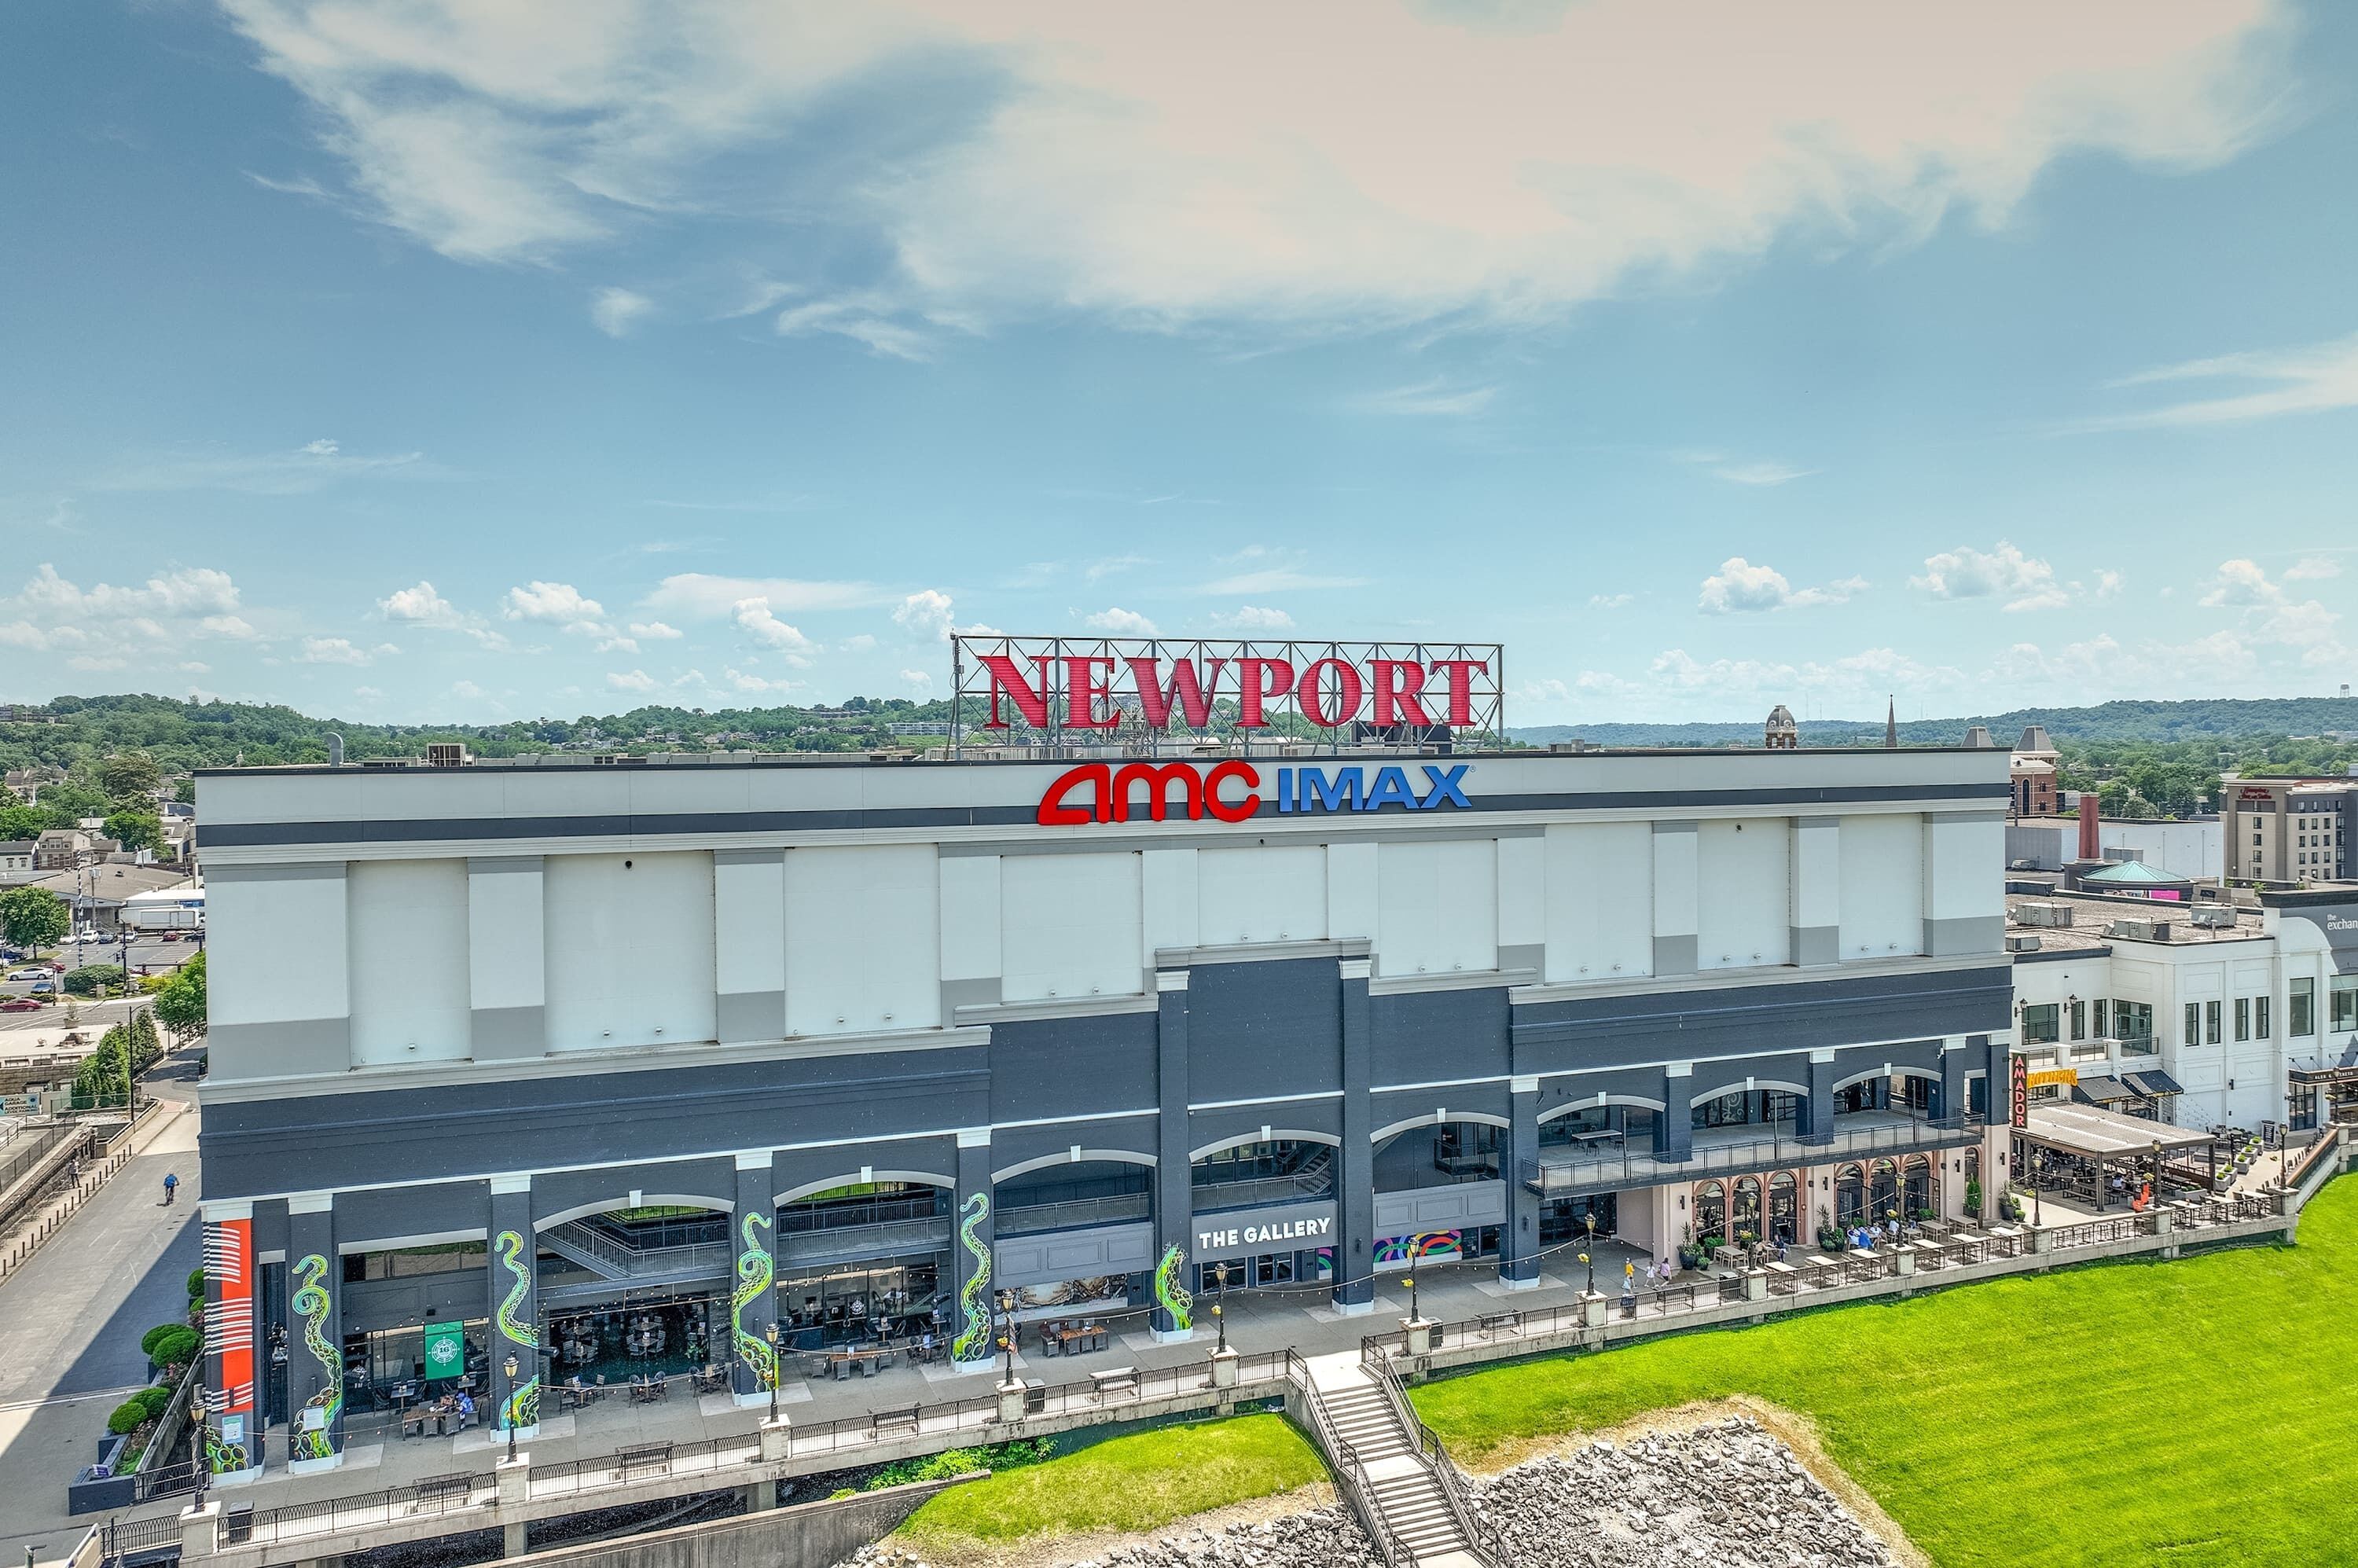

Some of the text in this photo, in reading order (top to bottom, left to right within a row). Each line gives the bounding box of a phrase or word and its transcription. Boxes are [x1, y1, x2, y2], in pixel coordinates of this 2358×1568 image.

[978, 655, 1489, 729] NEWPORT
[2014, 1055, 2026, 1126] AMADOR
[1199, 1217, 1331, 1250] THE GALLERY
